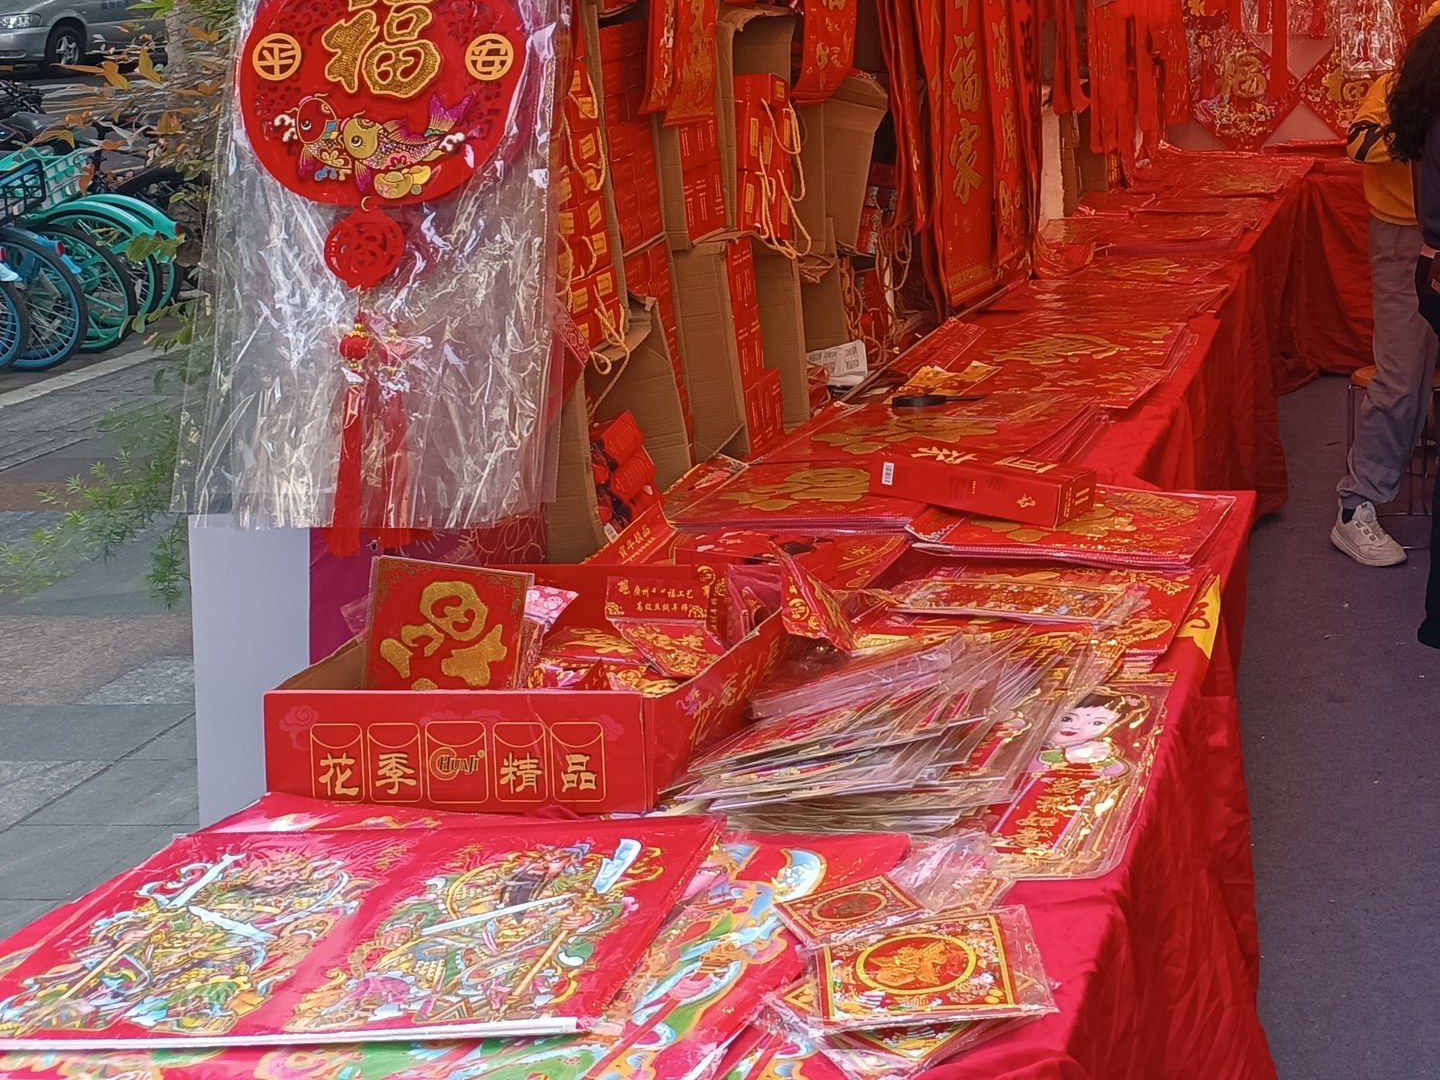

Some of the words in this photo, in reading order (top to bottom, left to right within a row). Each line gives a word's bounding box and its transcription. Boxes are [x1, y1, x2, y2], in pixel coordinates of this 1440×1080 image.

[470, 38, 511, 76] 安
[318, 752, 417, 796] 花季
[500, 752, 597, 794] 精品
